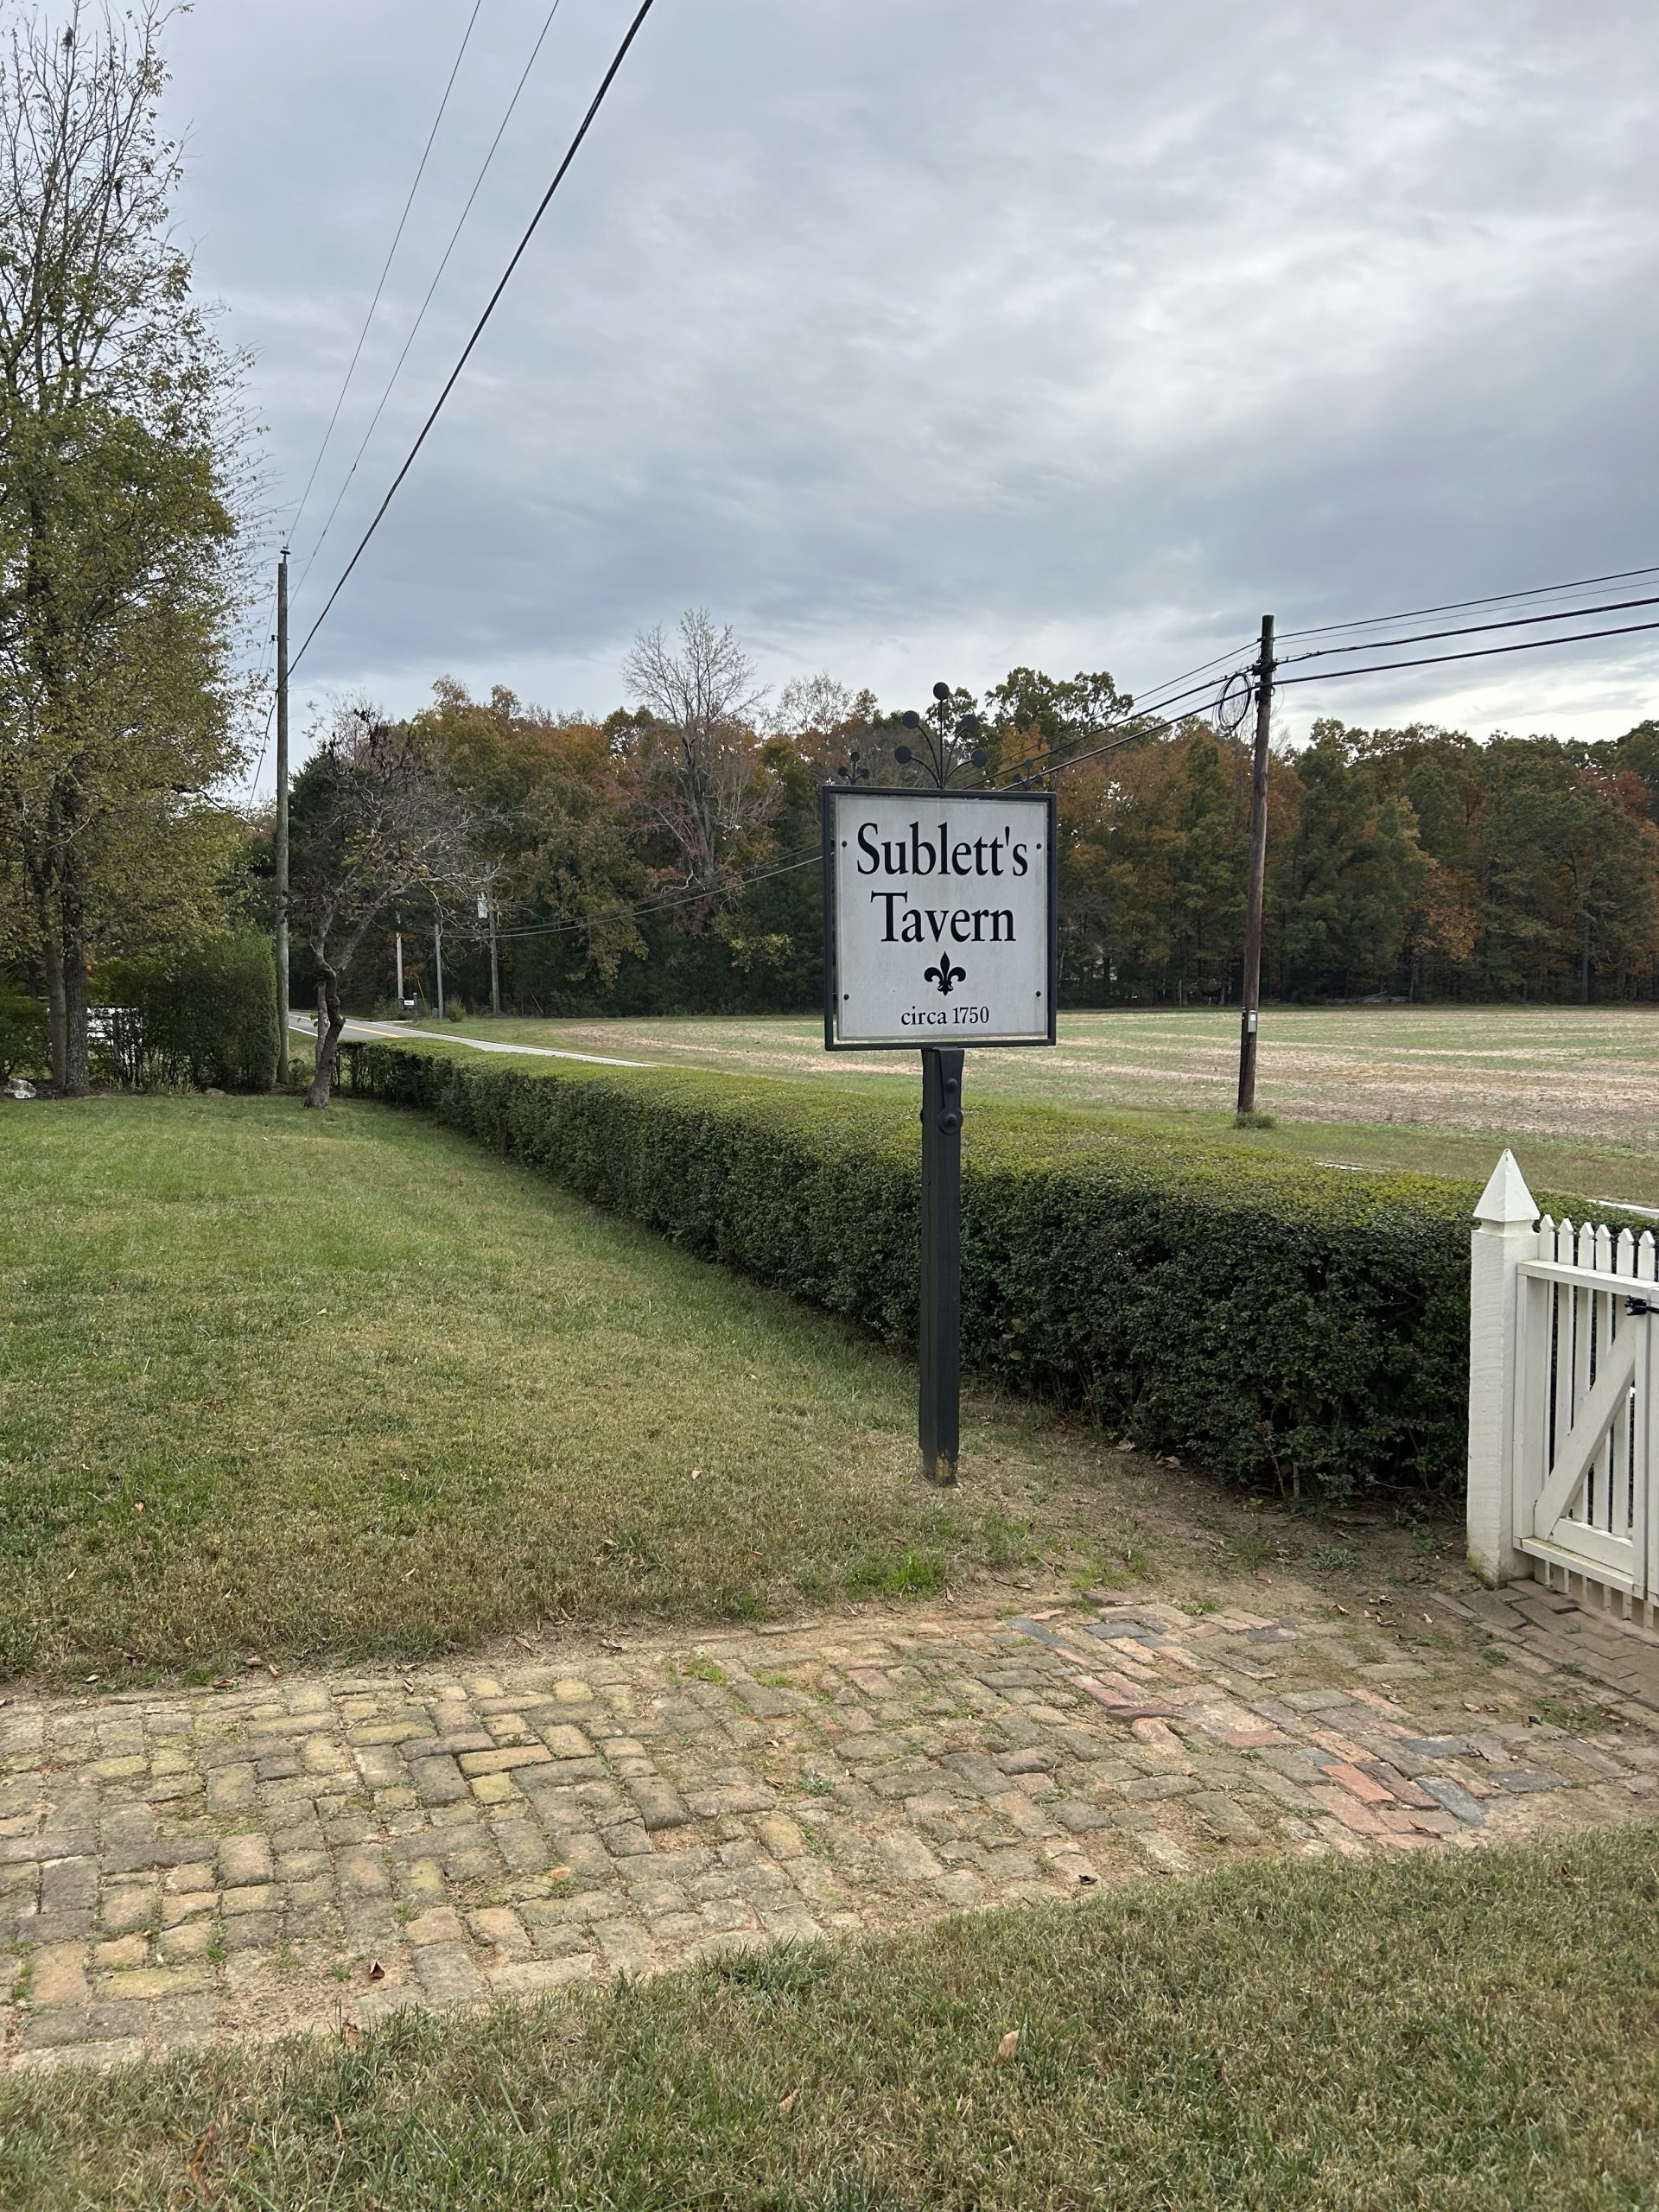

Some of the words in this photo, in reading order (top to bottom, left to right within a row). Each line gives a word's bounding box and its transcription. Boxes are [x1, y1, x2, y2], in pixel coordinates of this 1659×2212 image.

[856, 821, 1028, 877] Sublett's
[870, 890, 1017, 944] Tavern
[900, 1006, 947, 1026] circa
[951, 1006, 990, 1025] 1750
